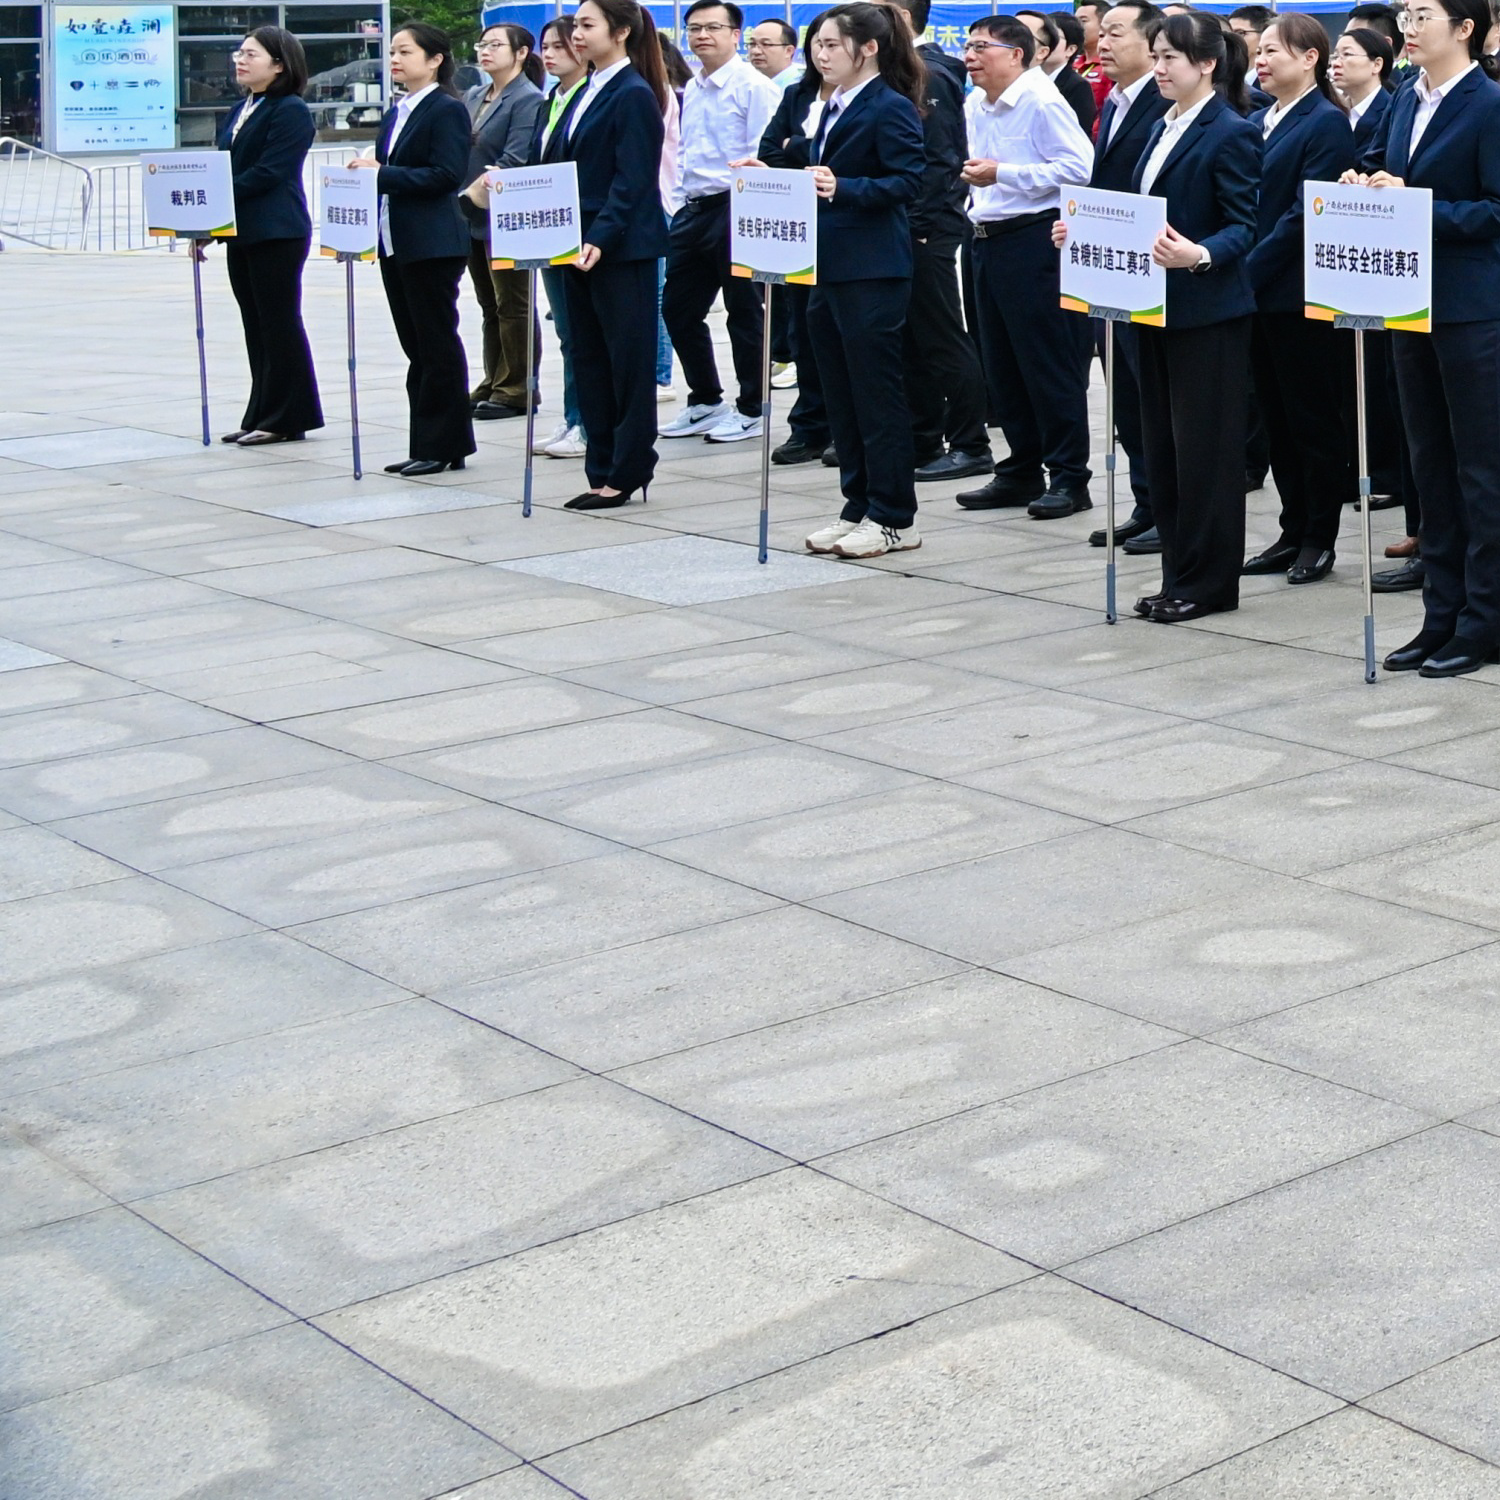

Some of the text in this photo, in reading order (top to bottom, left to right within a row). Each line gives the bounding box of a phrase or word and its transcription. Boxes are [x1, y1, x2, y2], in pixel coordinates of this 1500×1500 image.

[171, 189, 207, 206] 裁判员
[497, 207, 573, 232] 环境监测与检测技能赛项
[738, 216, 807, 243] 继电保护试验赛项
[1070, 241, 1150, 277] 食糖制造工赛项
[1315, 243, 1419, 278] 班组长安全技能赛项
